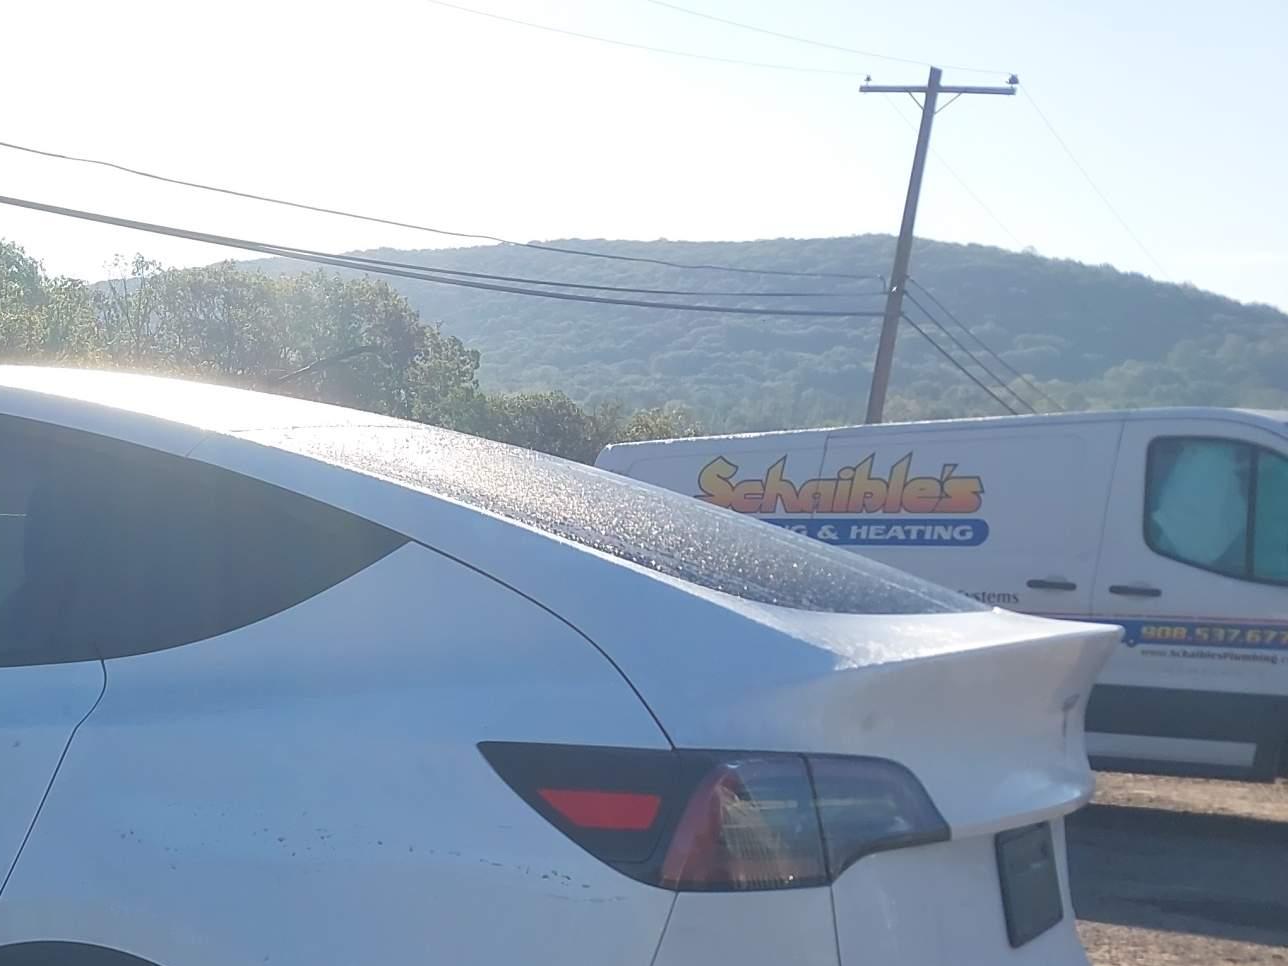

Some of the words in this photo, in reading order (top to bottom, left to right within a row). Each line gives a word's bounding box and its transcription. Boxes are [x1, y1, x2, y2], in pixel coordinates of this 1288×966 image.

[694, 452, 985, 513] Schaible's
[817, 525, 840, 540] &
[850, 525, 974, 540] HEATING
